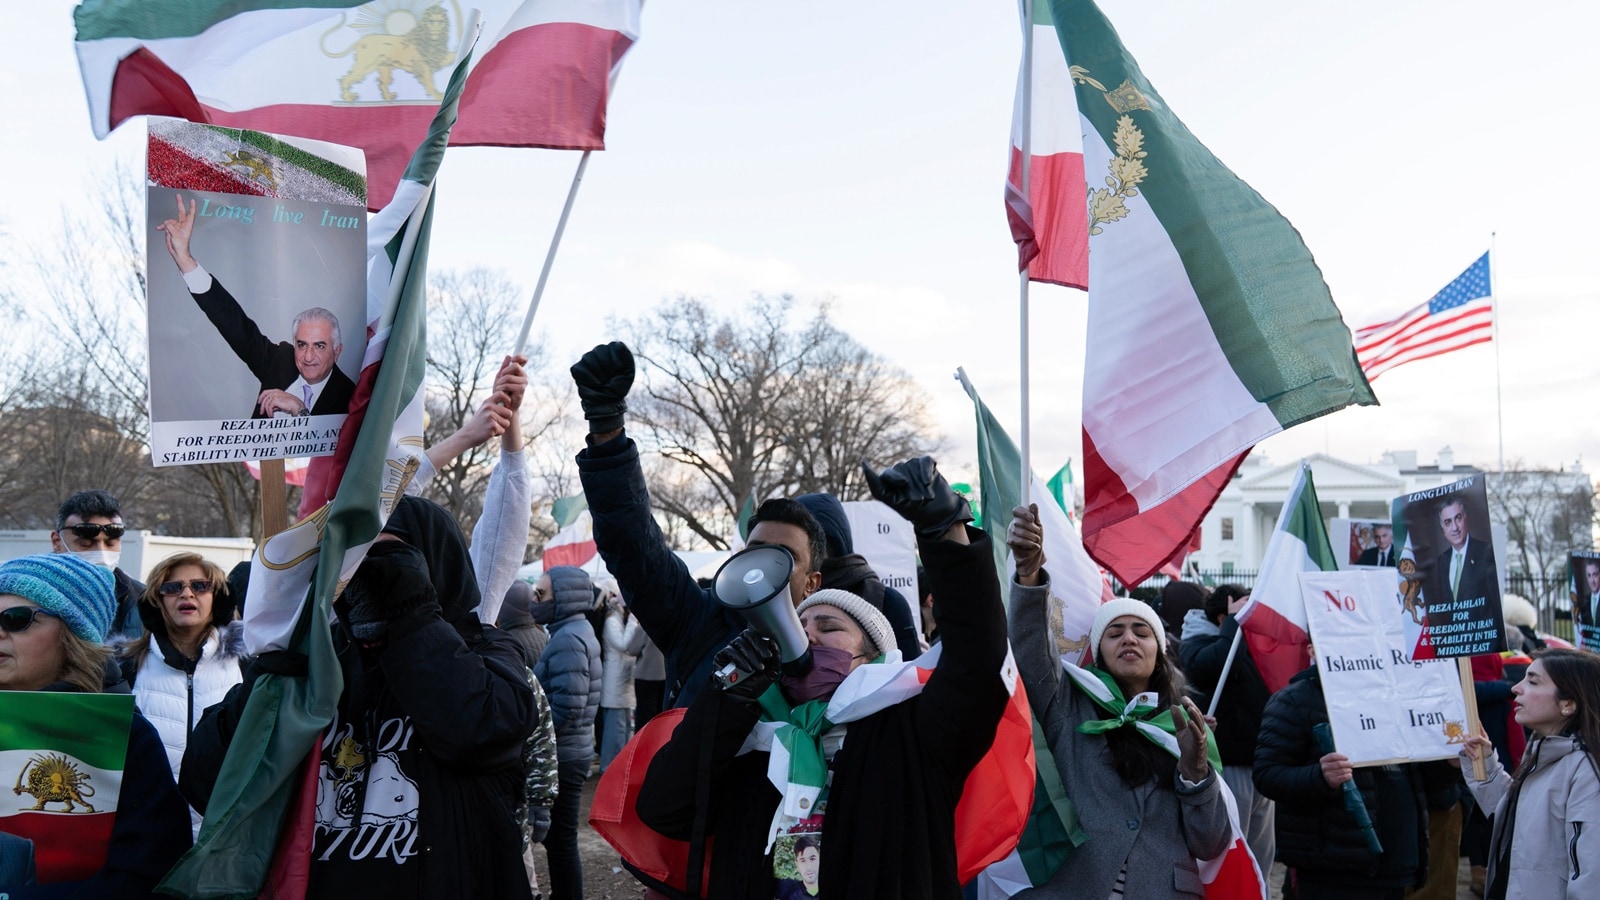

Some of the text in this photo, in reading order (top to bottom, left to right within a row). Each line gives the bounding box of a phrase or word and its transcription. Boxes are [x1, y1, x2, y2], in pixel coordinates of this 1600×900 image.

[199, 198, 359, 229] Long live Iran
[220, 417, 309, 431] REZA PAHLAVI
[176, 436, 203, 447] FOR
[207, 434, 273, 446] FREEDOM
[274, 432, 288, 443] IN
[290, 430, 320, 442] IRAN,
[162, 450, 231, 463] STABILITY
[233, 448, 249, 459] IN
[251, 447, 277, 458] THE
[283, 443, 327, 456] MIDDLE
[1408, 477, 1474, 502] LONG LIVE IRAN
[877, 522, 890, 535] to
[1322, 590, 1356, 612] No
[1428, 597, 1485, 613] REZA PAHLAVI
[1452, 611, 1470, 621] FOR
[1423, 618, 1494, 635] FREEDOM IN IRAN
[1420, 629, 1498, 646] & STABILITY IN THE
[1437, 642, 1491, 656] MIDDLE EAST
[1324, 654, 1384, 673] Islamic
[1359, 709, 1446, 731] in Iran
